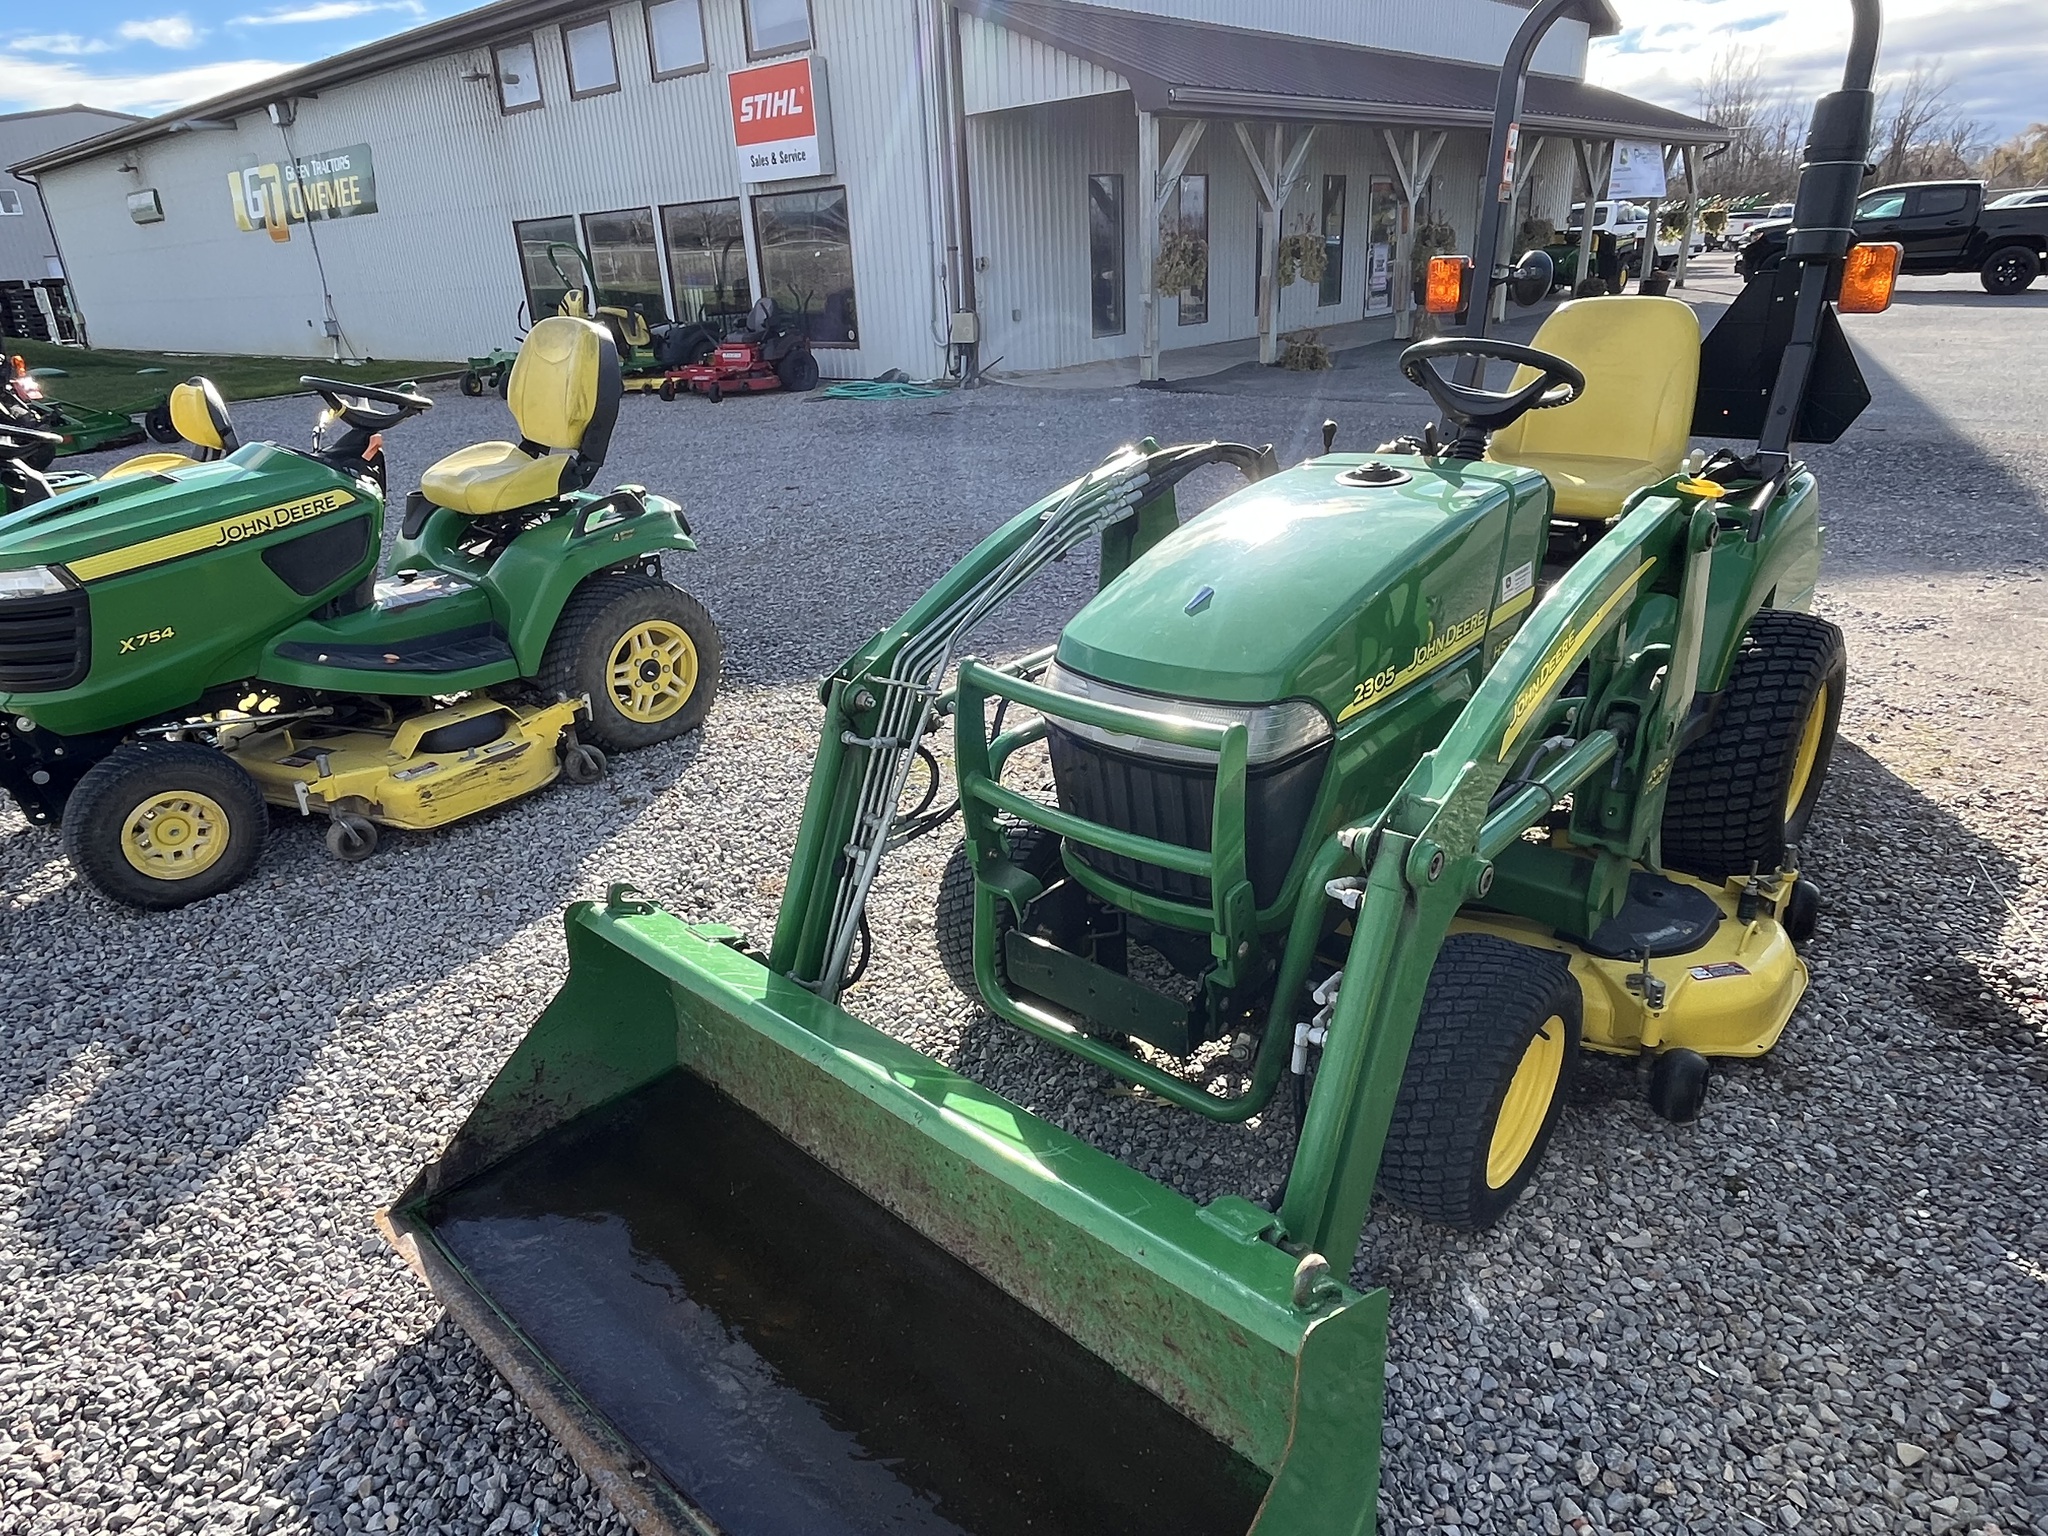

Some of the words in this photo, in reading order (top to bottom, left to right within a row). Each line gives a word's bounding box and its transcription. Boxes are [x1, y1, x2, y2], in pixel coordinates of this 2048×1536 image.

[740, 88, 803, 123] STIHL
[750, 154, 769, 168] Sales
[771, 152, 778, 165] &
[779, 149, 806, 164] Service
[288, 175, 361, 219] OMEMEE
[216, 515, 272, 545] JOHN
[273, 495, 338, 526] DEERE
[119, 626, 175, 655] X754
[1353, 665, 1396, 706] 2305
[1407, 634, 1446, 672] JOHN
[1445, 609, 1486, 648] DEERE
[1510, 677, 1541, 729] JOHN
[1540, 629, 1576, 687] DEERE
